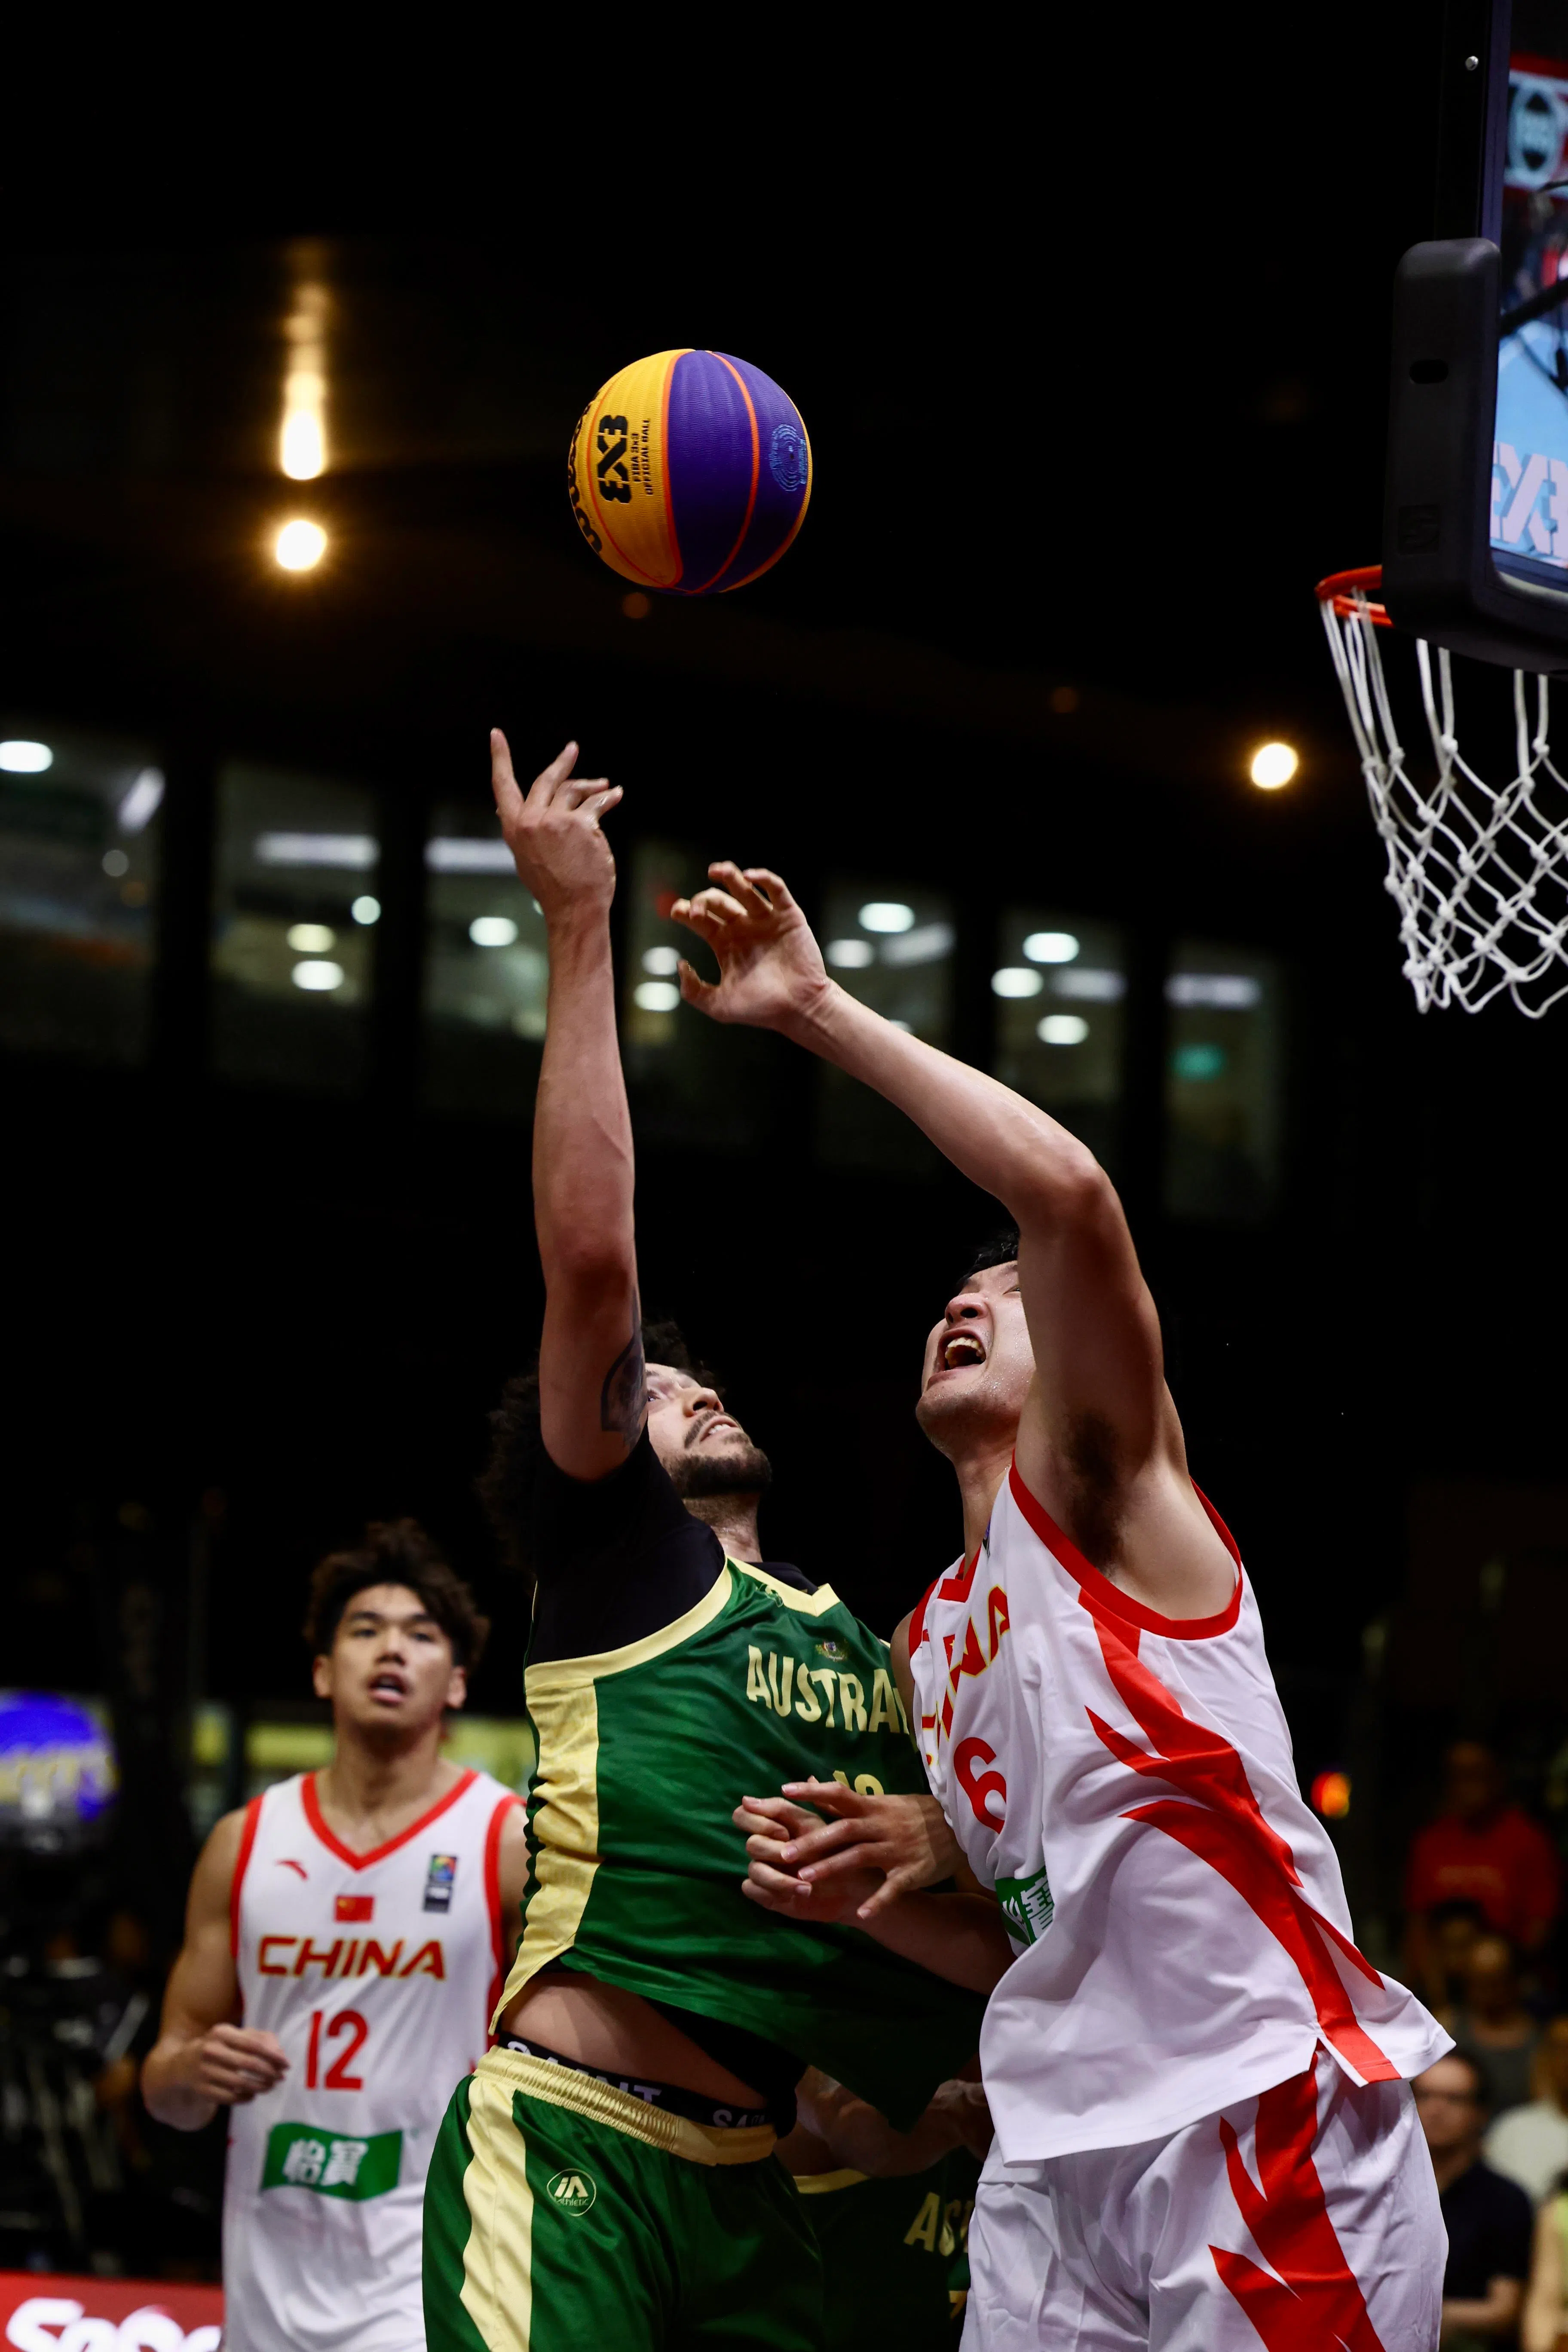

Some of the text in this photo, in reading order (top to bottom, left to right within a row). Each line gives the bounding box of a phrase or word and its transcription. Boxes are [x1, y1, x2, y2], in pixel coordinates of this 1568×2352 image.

[641, 419, 653, 495] OFFICIAL BALL
[953, 1737, 1007, 1834] 6
[259, 1936, 446, 1981] CHINA
[306, 2009, 370, 2092] 12
